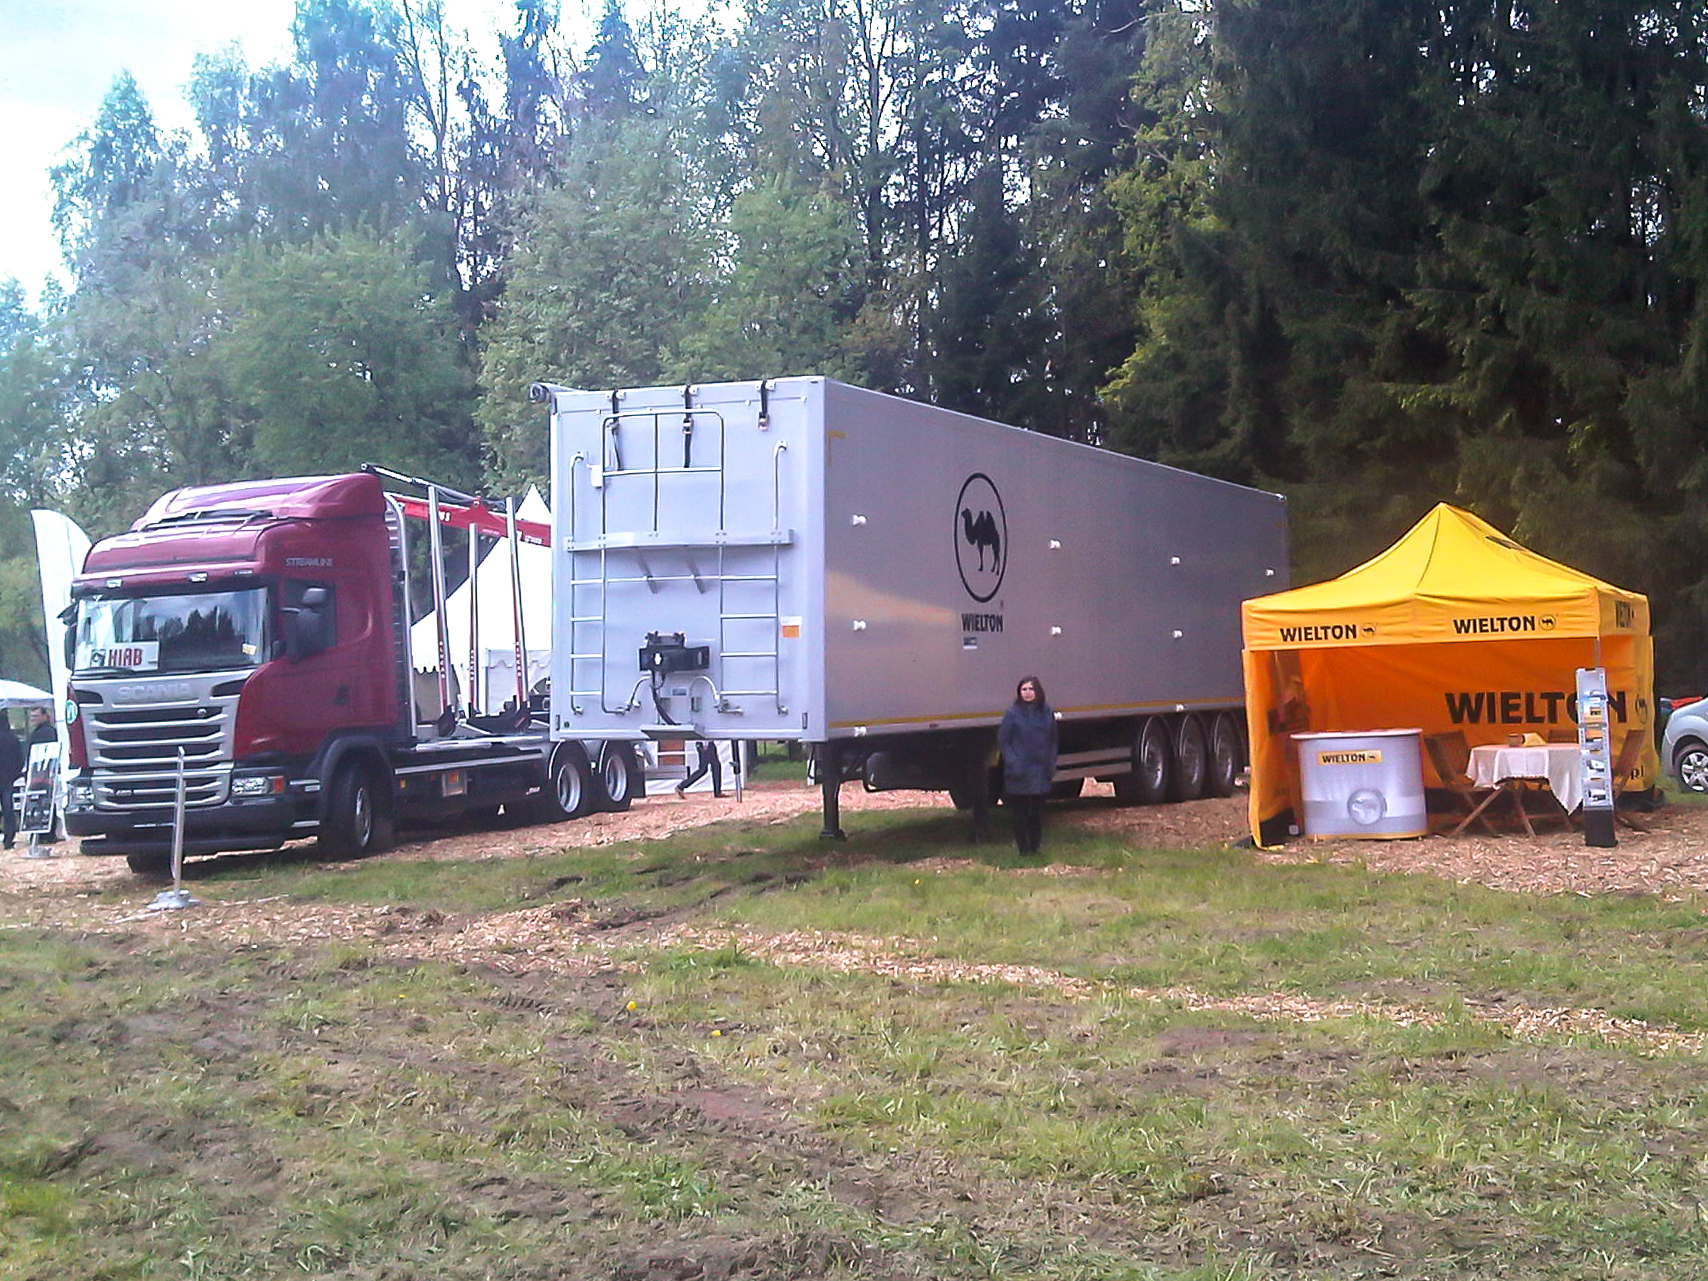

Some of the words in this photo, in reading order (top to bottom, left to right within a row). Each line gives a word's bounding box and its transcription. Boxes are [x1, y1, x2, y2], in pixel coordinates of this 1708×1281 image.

[961, 612, 1004, 633] WIELTON
[1453, 615, 1536, 635] WIELTON
[1279, 624, 1357, 642] WIELTON
[108, 647, 143, 667] HIAB
[1321, 752, 1366, 763] WIELTON
